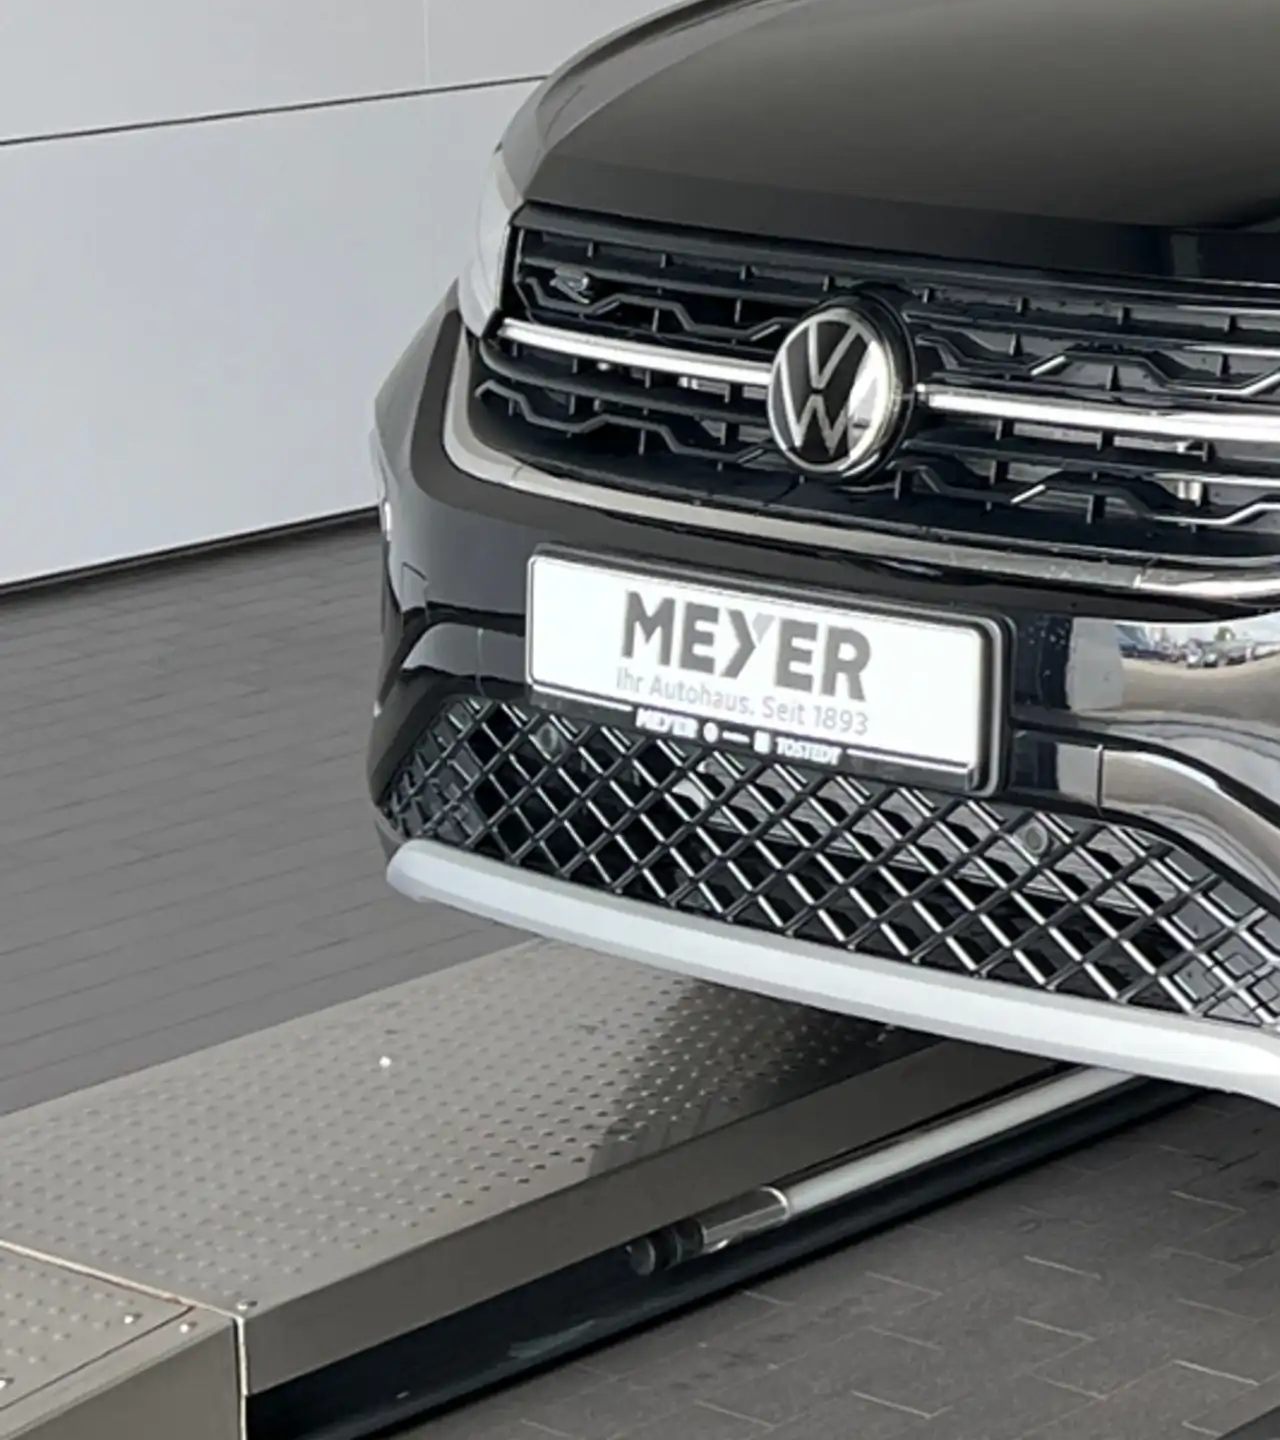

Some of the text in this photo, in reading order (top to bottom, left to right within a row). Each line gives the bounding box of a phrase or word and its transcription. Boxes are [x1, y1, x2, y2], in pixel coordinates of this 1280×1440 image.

[768, 308, 891, 472] VW
[616, 667, 869, 736] Ihr Autohaus. Seit 1893
[621, 590, 872, 702] MEYER
